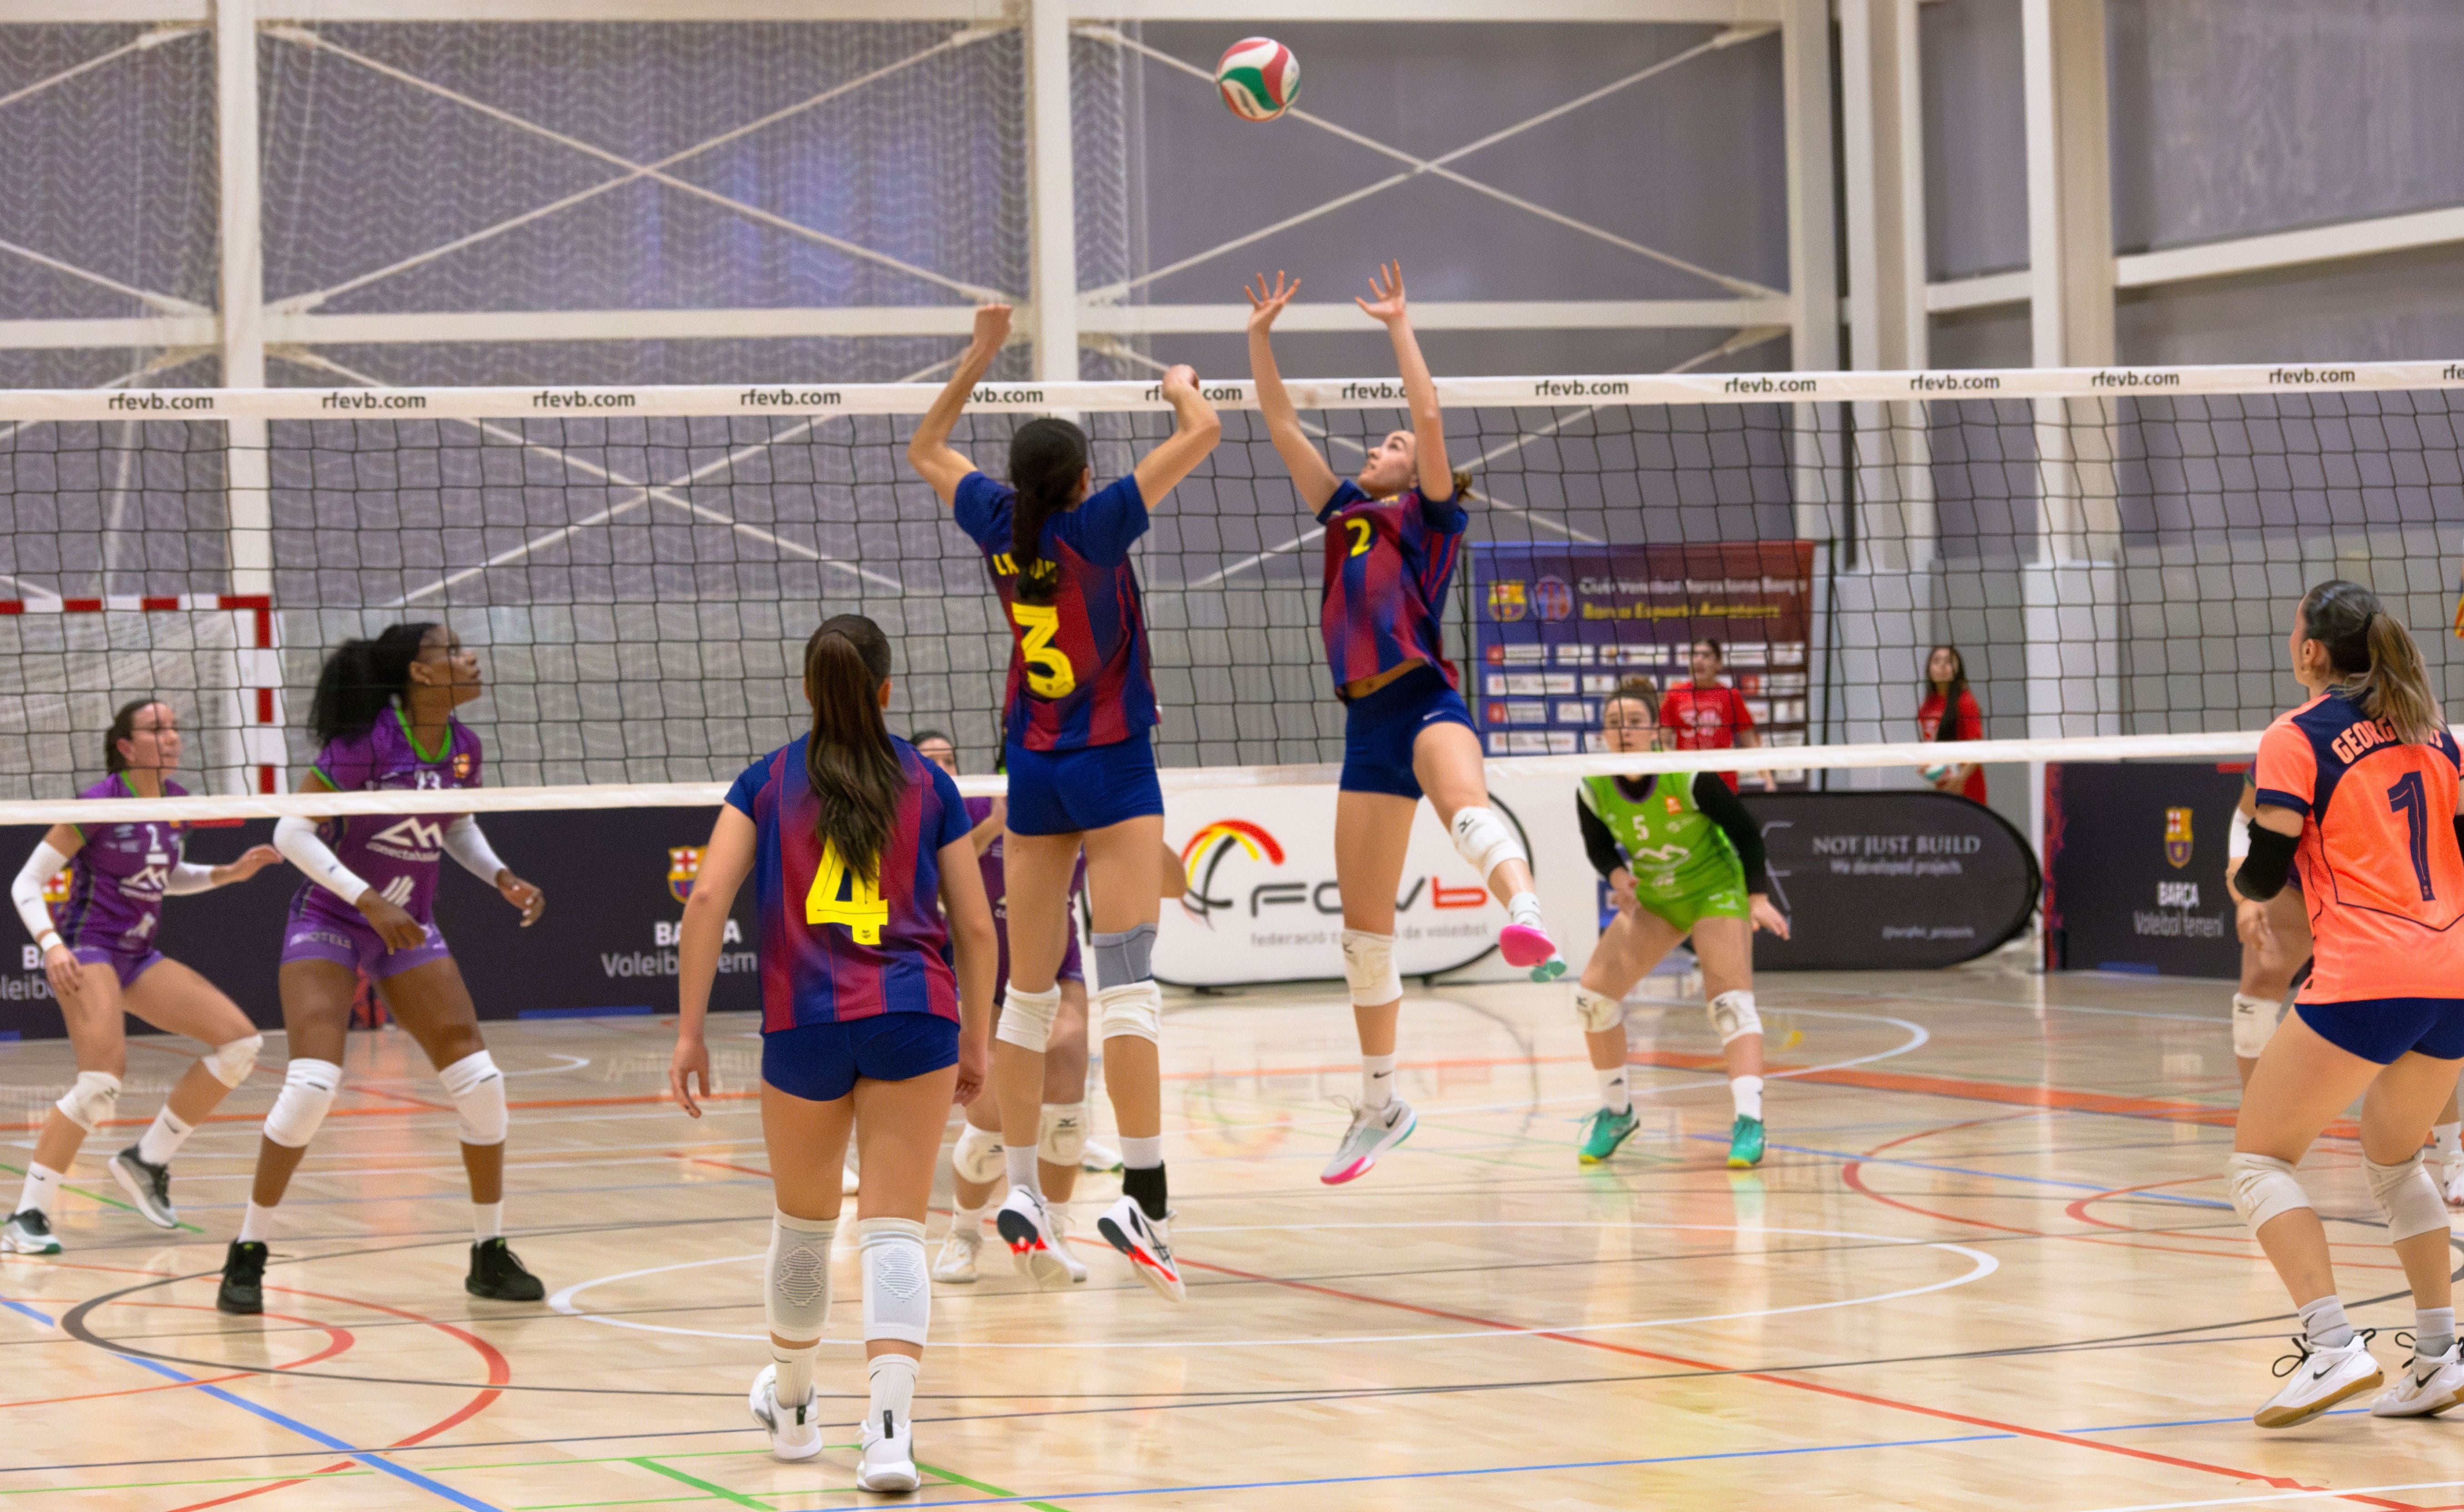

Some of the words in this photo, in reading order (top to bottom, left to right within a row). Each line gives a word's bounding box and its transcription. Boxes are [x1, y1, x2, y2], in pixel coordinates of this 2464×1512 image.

[1910, 374, 2000, 390] rfevb.com
[2091, 370, 2180, 387] rfevb.com
[2269, 368, 2355, 383] rfevb.com
[1145, 385, 1243, 401] rfcom
[1535, 380, 1629, 396] rfevb.com
[1725, 377, 1816, 393] rfevb.com
[109, 393, 214, 410] rfevb.com
[322, 391, 426, 409] rfevb.com
[533, 390, 635, 408] rfevb.com
[741, 388, 841, 406] rfevb.com
[967, 387, 1043, 403] vb.com
[1345, 517, 1371, 557] 2
[1011, 601, 1076, 699] 3
[1633, 815, 1649, 840] 5
[2387, 771, 2436, 902] 1
[1813, 836, 1859, 854] NOT
[1864, 836, 1910, 856] JUST
[1916, 835, 1981, 854] BUILD
[806, 834, 888, 945] 4
